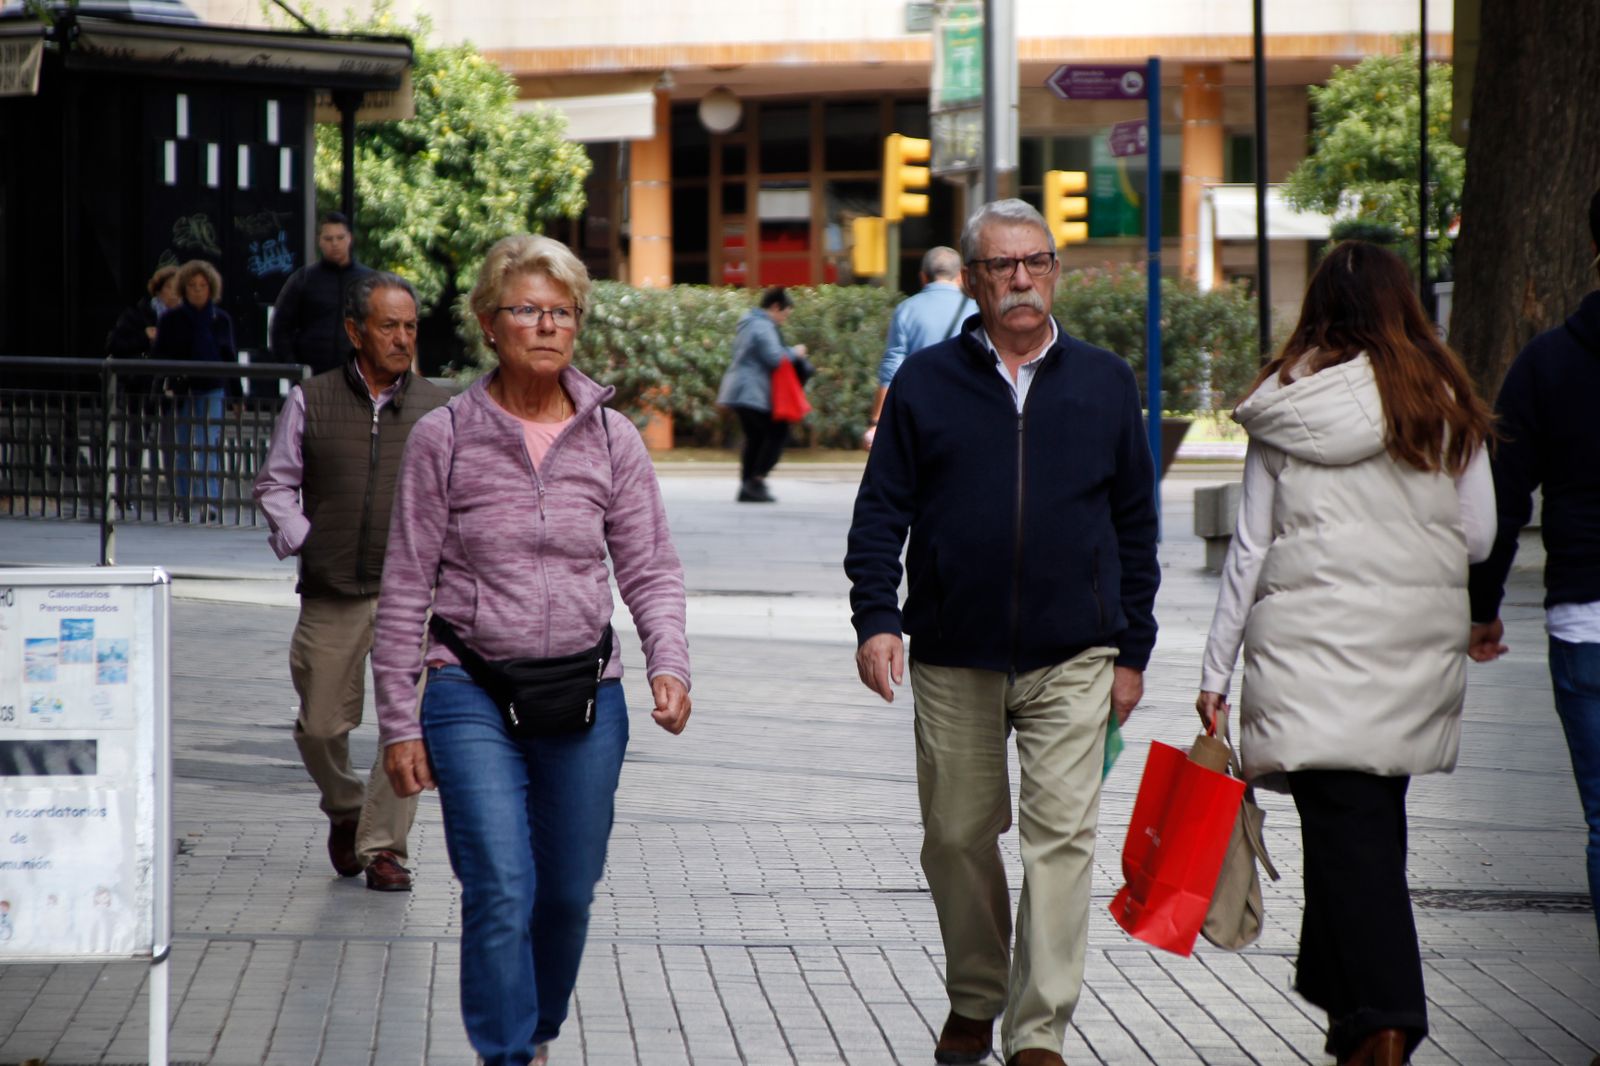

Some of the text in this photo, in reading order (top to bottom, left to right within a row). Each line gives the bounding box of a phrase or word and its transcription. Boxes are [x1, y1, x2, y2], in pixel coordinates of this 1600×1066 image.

[48, 589, 111, 599] Calendarios
[39, 603, 119, 612] Personalizados
[5, 804, 107, 818] recordatorios
[9, 832, 28, 844] de
[0, 855, 52, 870] munión
